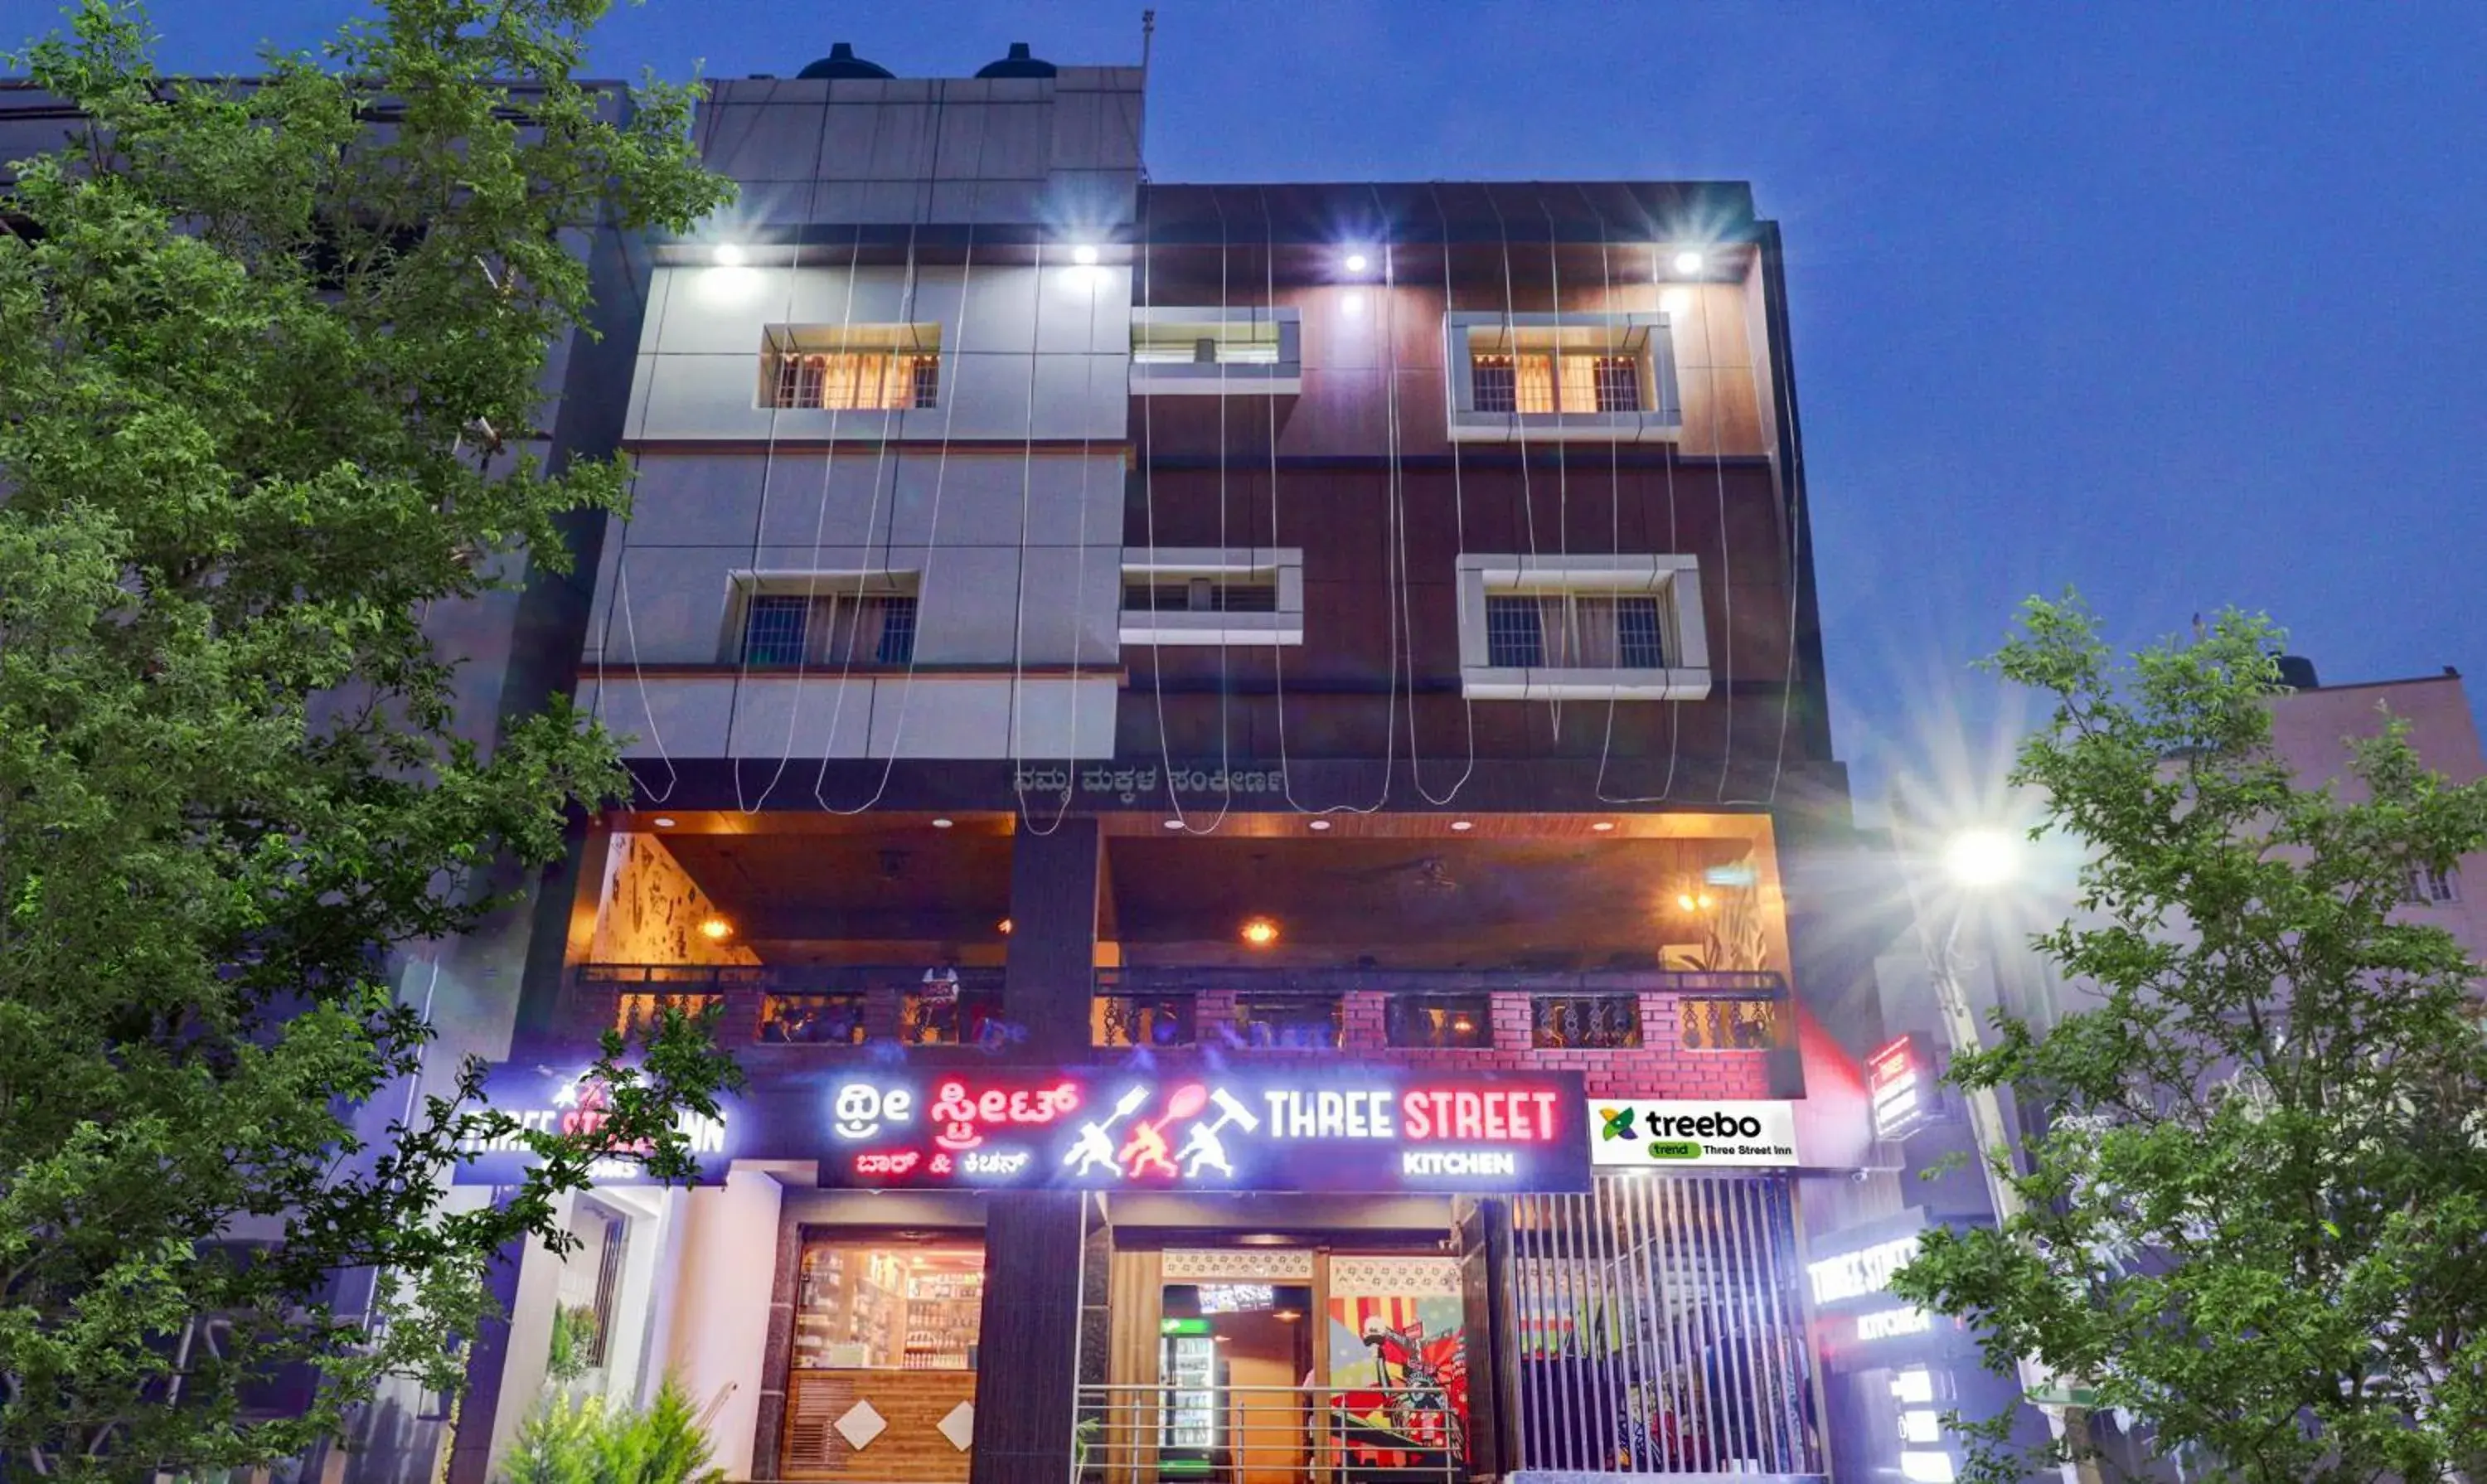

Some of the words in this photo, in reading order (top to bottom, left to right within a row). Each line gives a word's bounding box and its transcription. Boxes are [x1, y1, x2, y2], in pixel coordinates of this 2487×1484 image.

[1264, 1089, 1394, 1139] THREE
[1403, 1089, 1557, 1141] STREET
[1646, 1111, 1762, 1137] treebo
[1653, 1143, 1689, 1155] trend
[1703, 1145, 1735, 1155] Three
[1738, 1145, 1772, 1155] Street
[1774, 1145, 1792, 1155] Inn
[928, 1153, 952, 1172] &
[1403, 1152, 1515, 1176] KITCHEN
